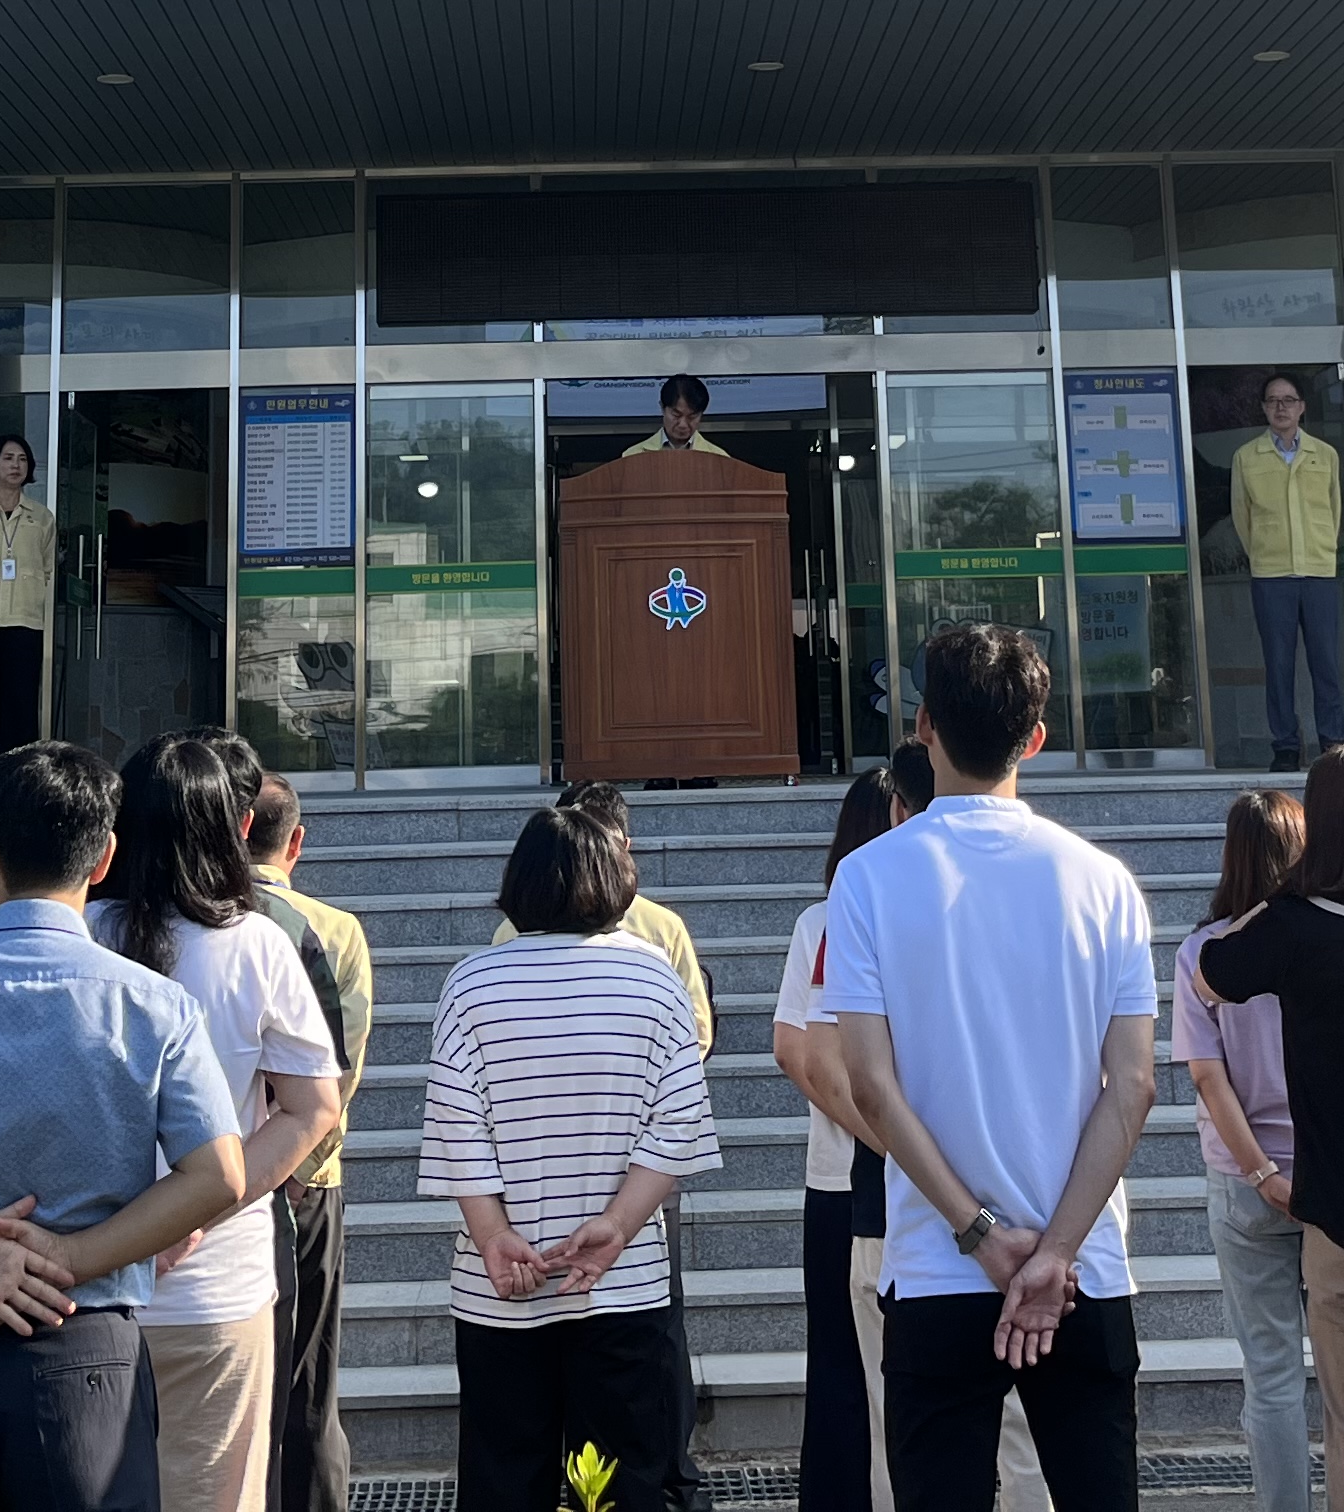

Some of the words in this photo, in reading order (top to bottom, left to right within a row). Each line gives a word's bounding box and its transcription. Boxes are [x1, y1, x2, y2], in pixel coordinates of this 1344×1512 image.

[941, 557, 969, 570] 방문을
[971, 556, 1018, 569] 환영합니다
[412, 572, 439, 585] 방문을
[442, 571, 490, 584] 환영합니다
[1082, 625, 1130, 642] 영합니다
